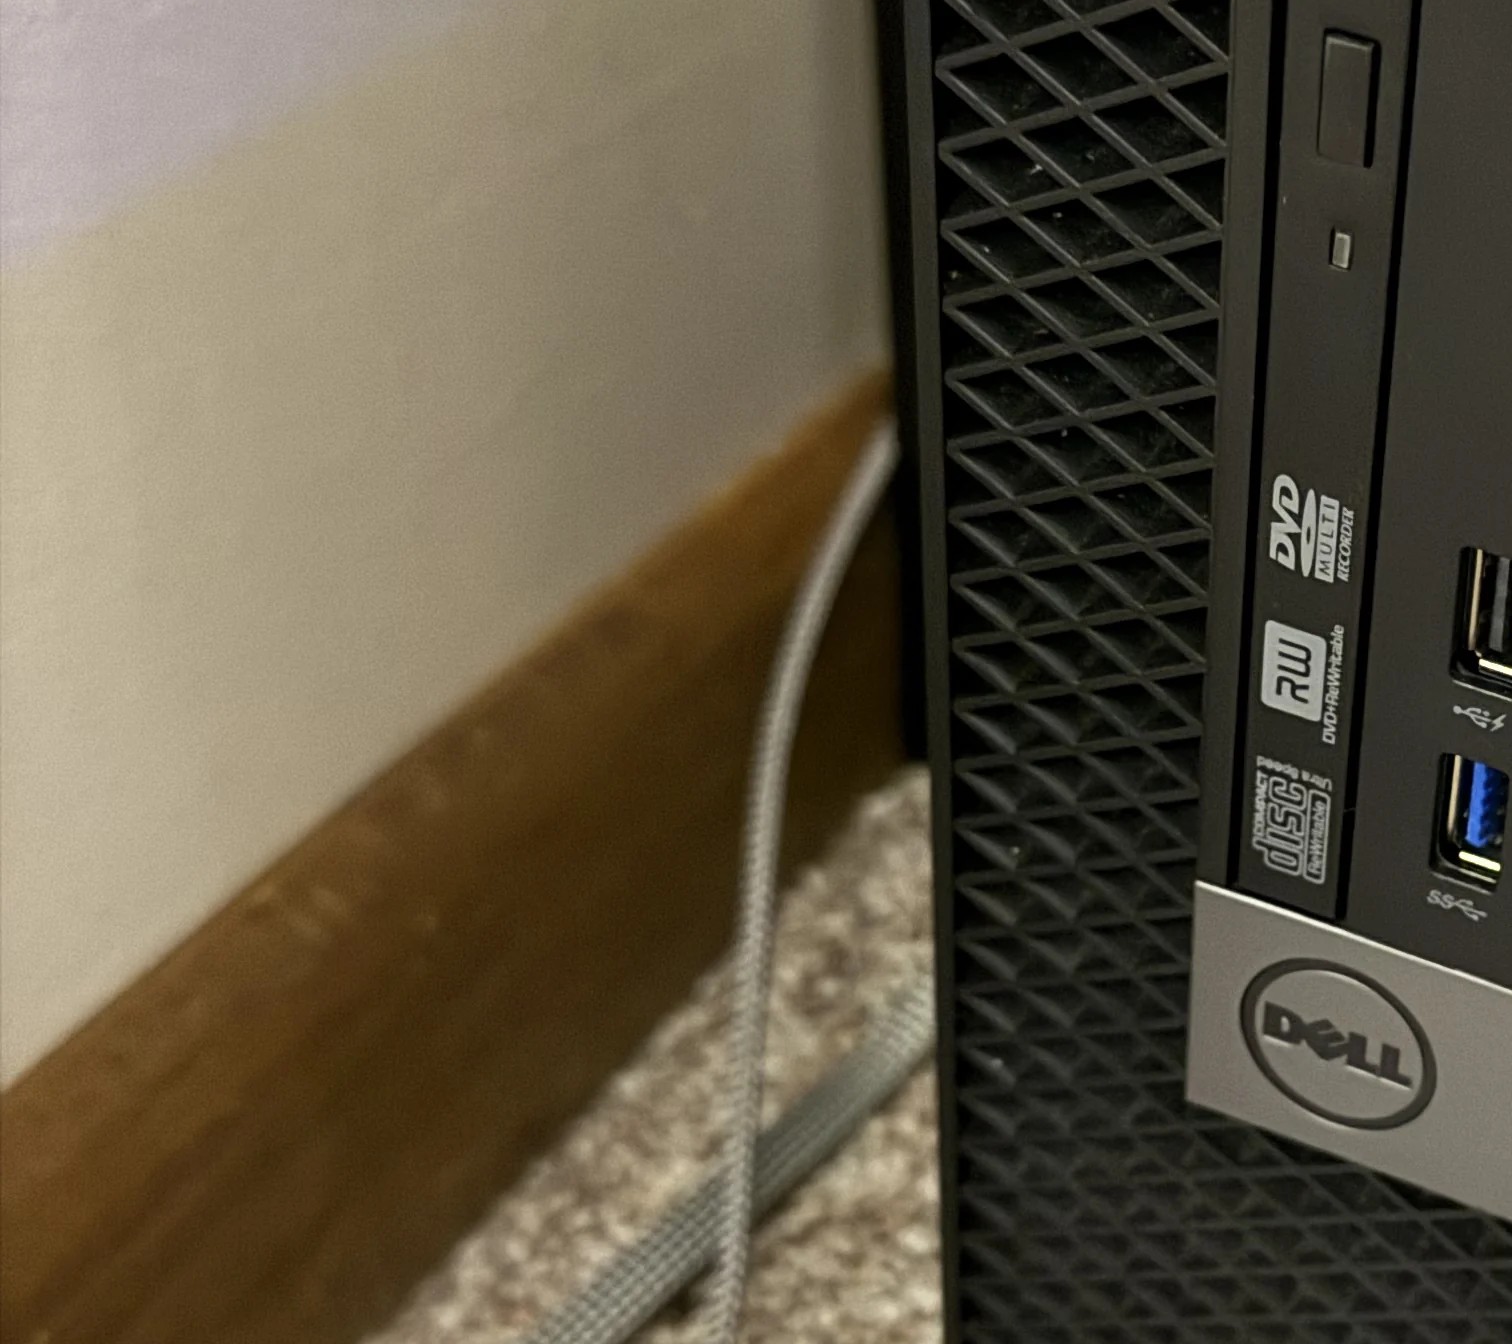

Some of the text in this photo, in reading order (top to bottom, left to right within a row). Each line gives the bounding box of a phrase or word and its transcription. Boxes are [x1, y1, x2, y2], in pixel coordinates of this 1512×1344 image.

[1269, 474, 1301, 571] DVD
[1317, 500, 1337, 578] MULTI
[1337, 506, 1354, 582] RECORDER
[1276, 637, 1311, 704] RW
[1322, 624, 1344, 745] DVD+ReWritable
[1254, 769, 1268, 837] COMPACT
[1263, 1000, 1412, 1089] DELL
